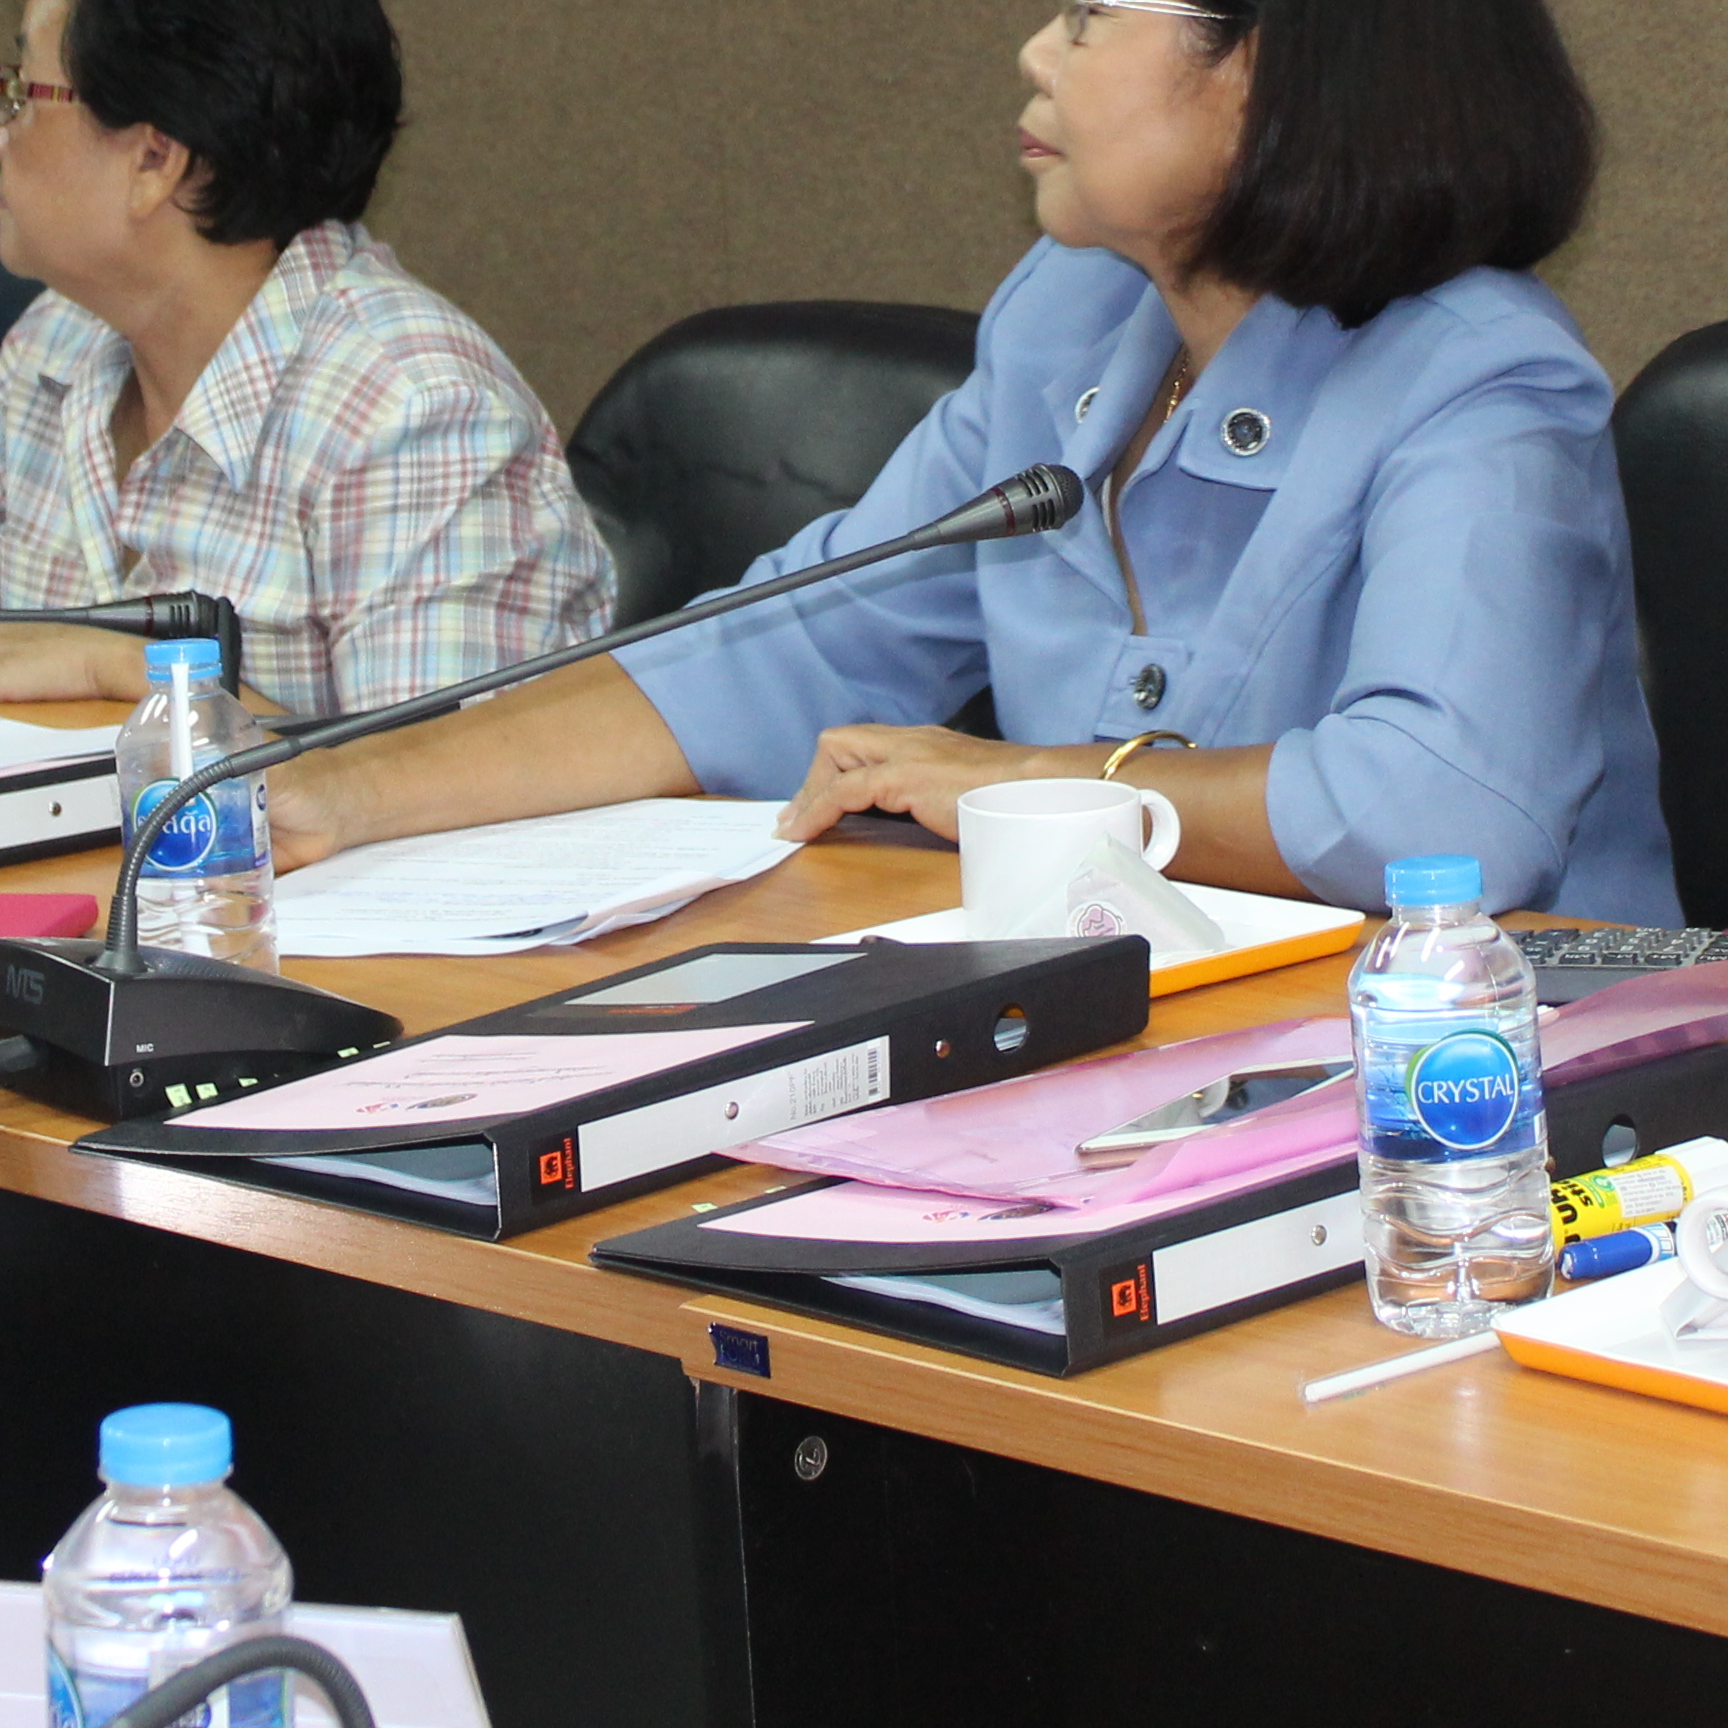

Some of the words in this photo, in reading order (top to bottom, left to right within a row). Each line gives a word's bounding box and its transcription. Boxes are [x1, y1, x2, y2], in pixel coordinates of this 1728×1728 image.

[136, 1043, 154, 1053] MIC
[1418, 1074, 1514, 1103] CRYSTAL
[1137, 1264, 1151, 1321] Elephant
